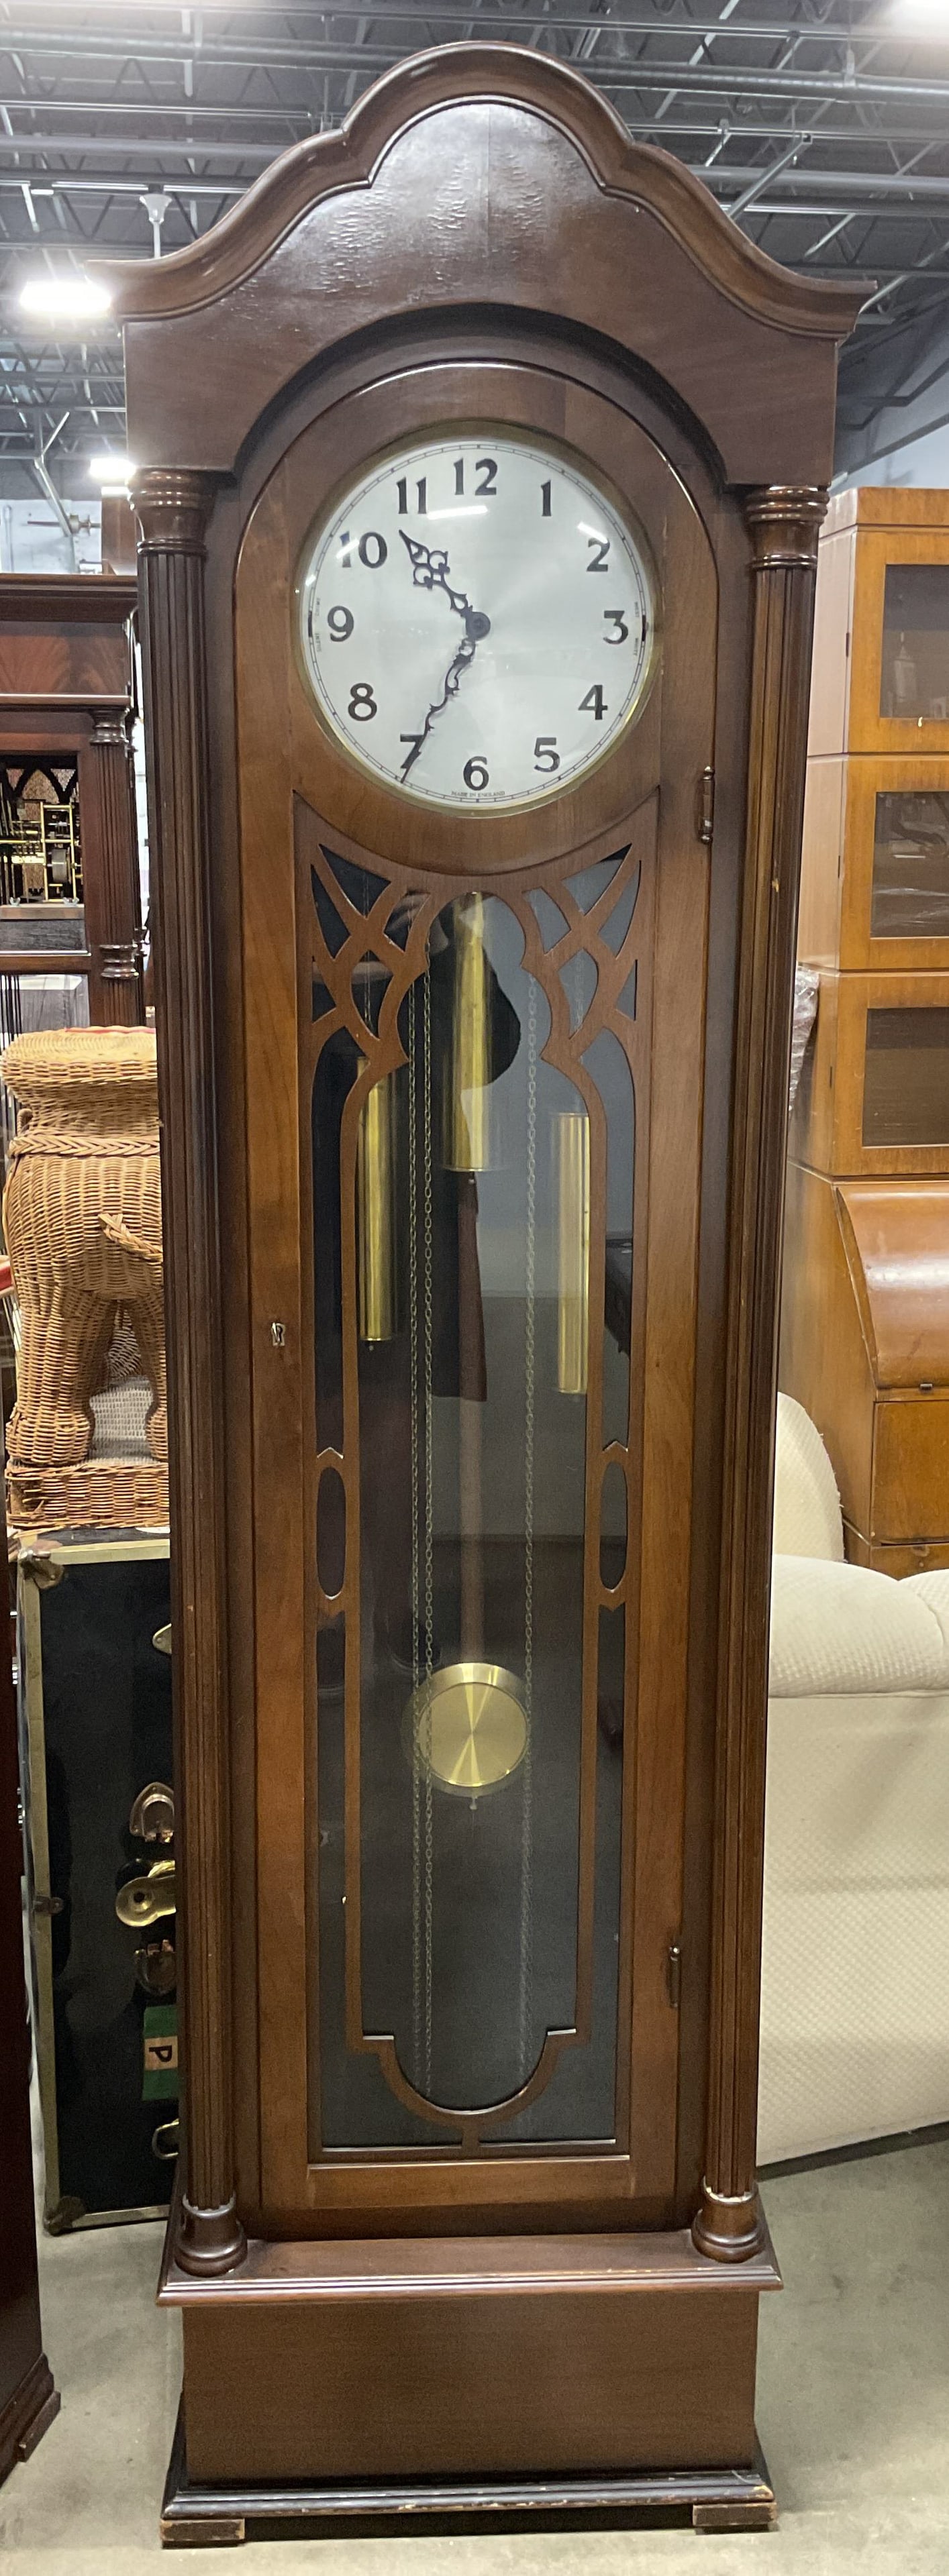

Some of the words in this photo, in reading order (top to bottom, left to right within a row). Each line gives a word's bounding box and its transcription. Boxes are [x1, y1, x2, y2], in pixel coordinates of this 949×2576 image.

[454, 458, 498, 496] 12
[397, 477, 427, 515] 11
[540, 480, 552, 517] 1
[340, 531, 388, 569] 10
[586, 538, 610, 572] 2
[327, 606, 354, 642] 9
[603, 610, 629, 645] 3
[347, 683, 378, 721] 8
[578, 684, 608, 720] 4
[399, 734, 426, 769] 7
[534, 737, 560, 773] 5
[463, 756, 489, 791] 6
[148, 2045, 172, 2063] P
